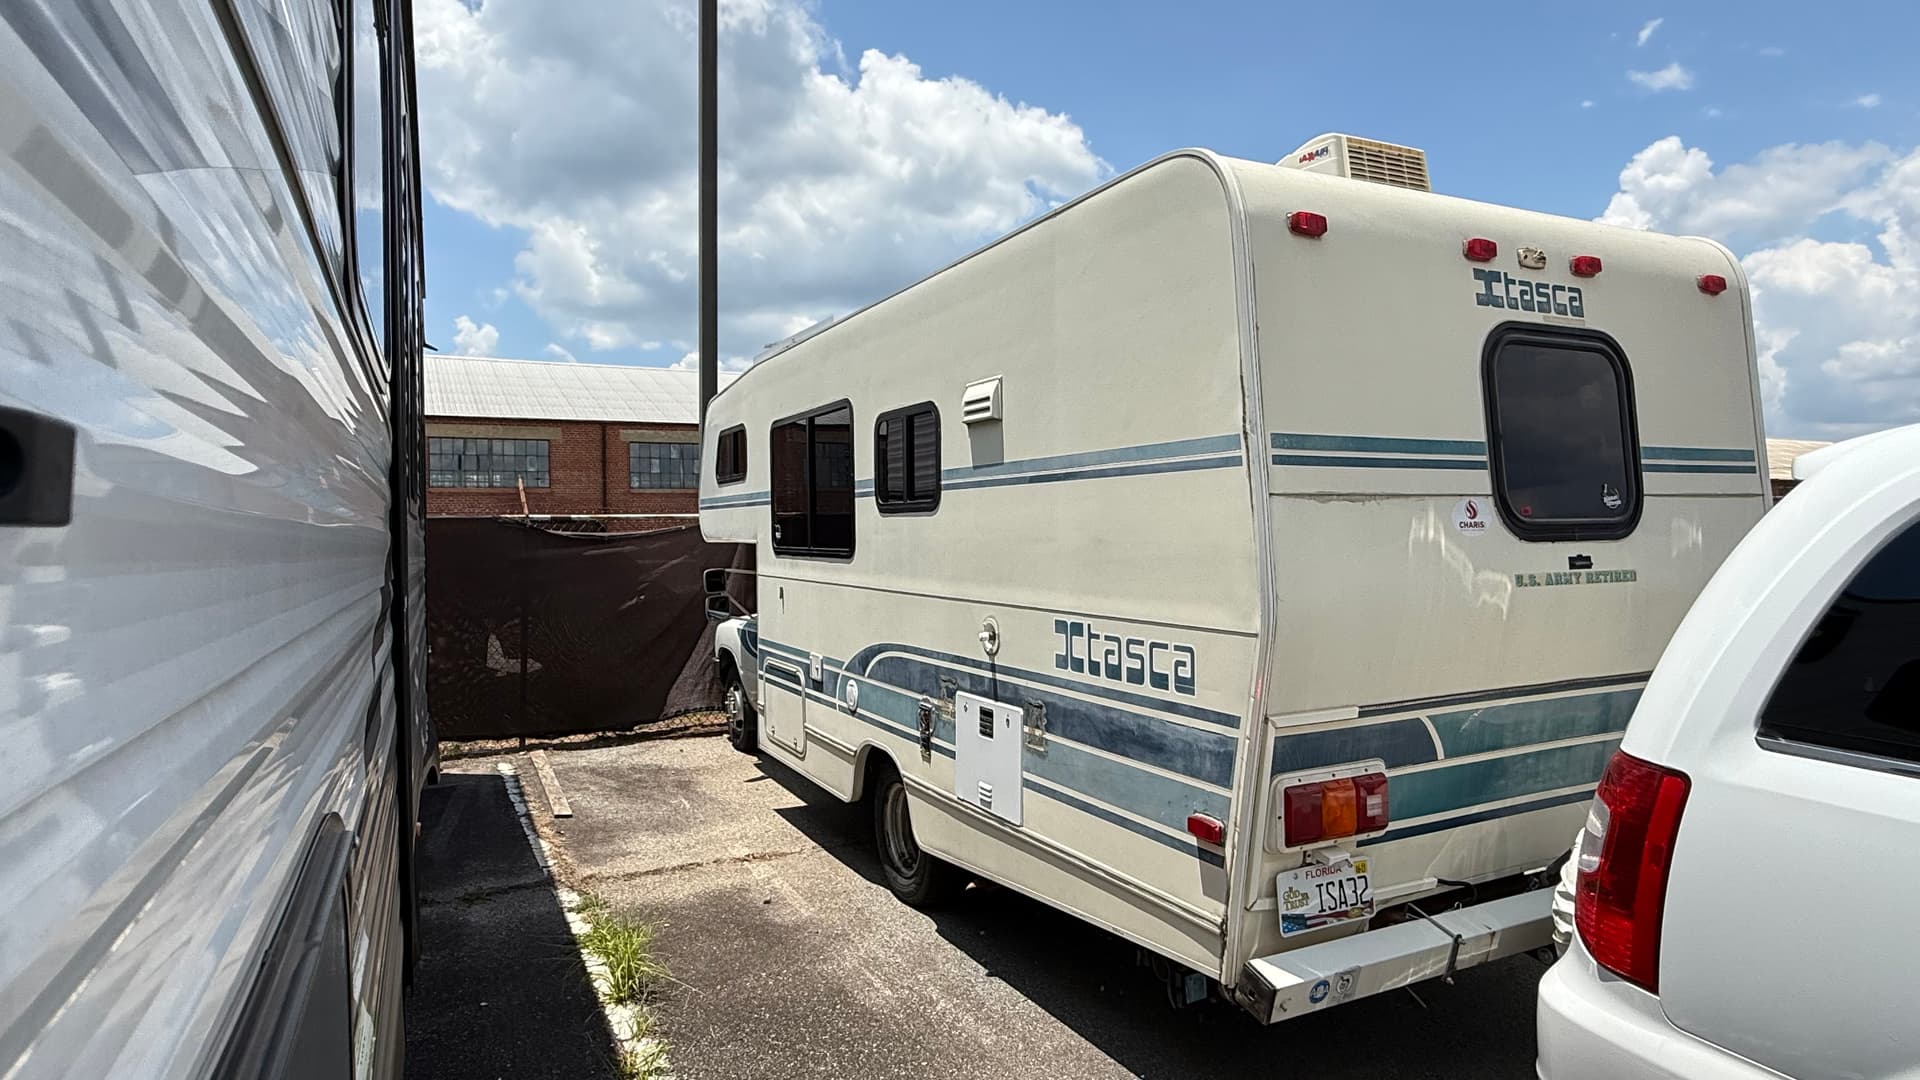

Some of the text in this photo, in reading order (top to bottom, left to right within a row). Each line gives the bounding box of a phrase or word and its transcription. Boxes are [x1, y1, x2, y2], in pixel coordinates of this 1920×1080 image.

[1473, 268, 1584, 317] Itasca
[1459, 521, 1485, 529] CHARIS
[1515, 569, 1637, 587] U.S. ARMY RETIRED
[1054, 619, 1195, 696] Itasca
[1316, 875, 1370, 913] ISA32
